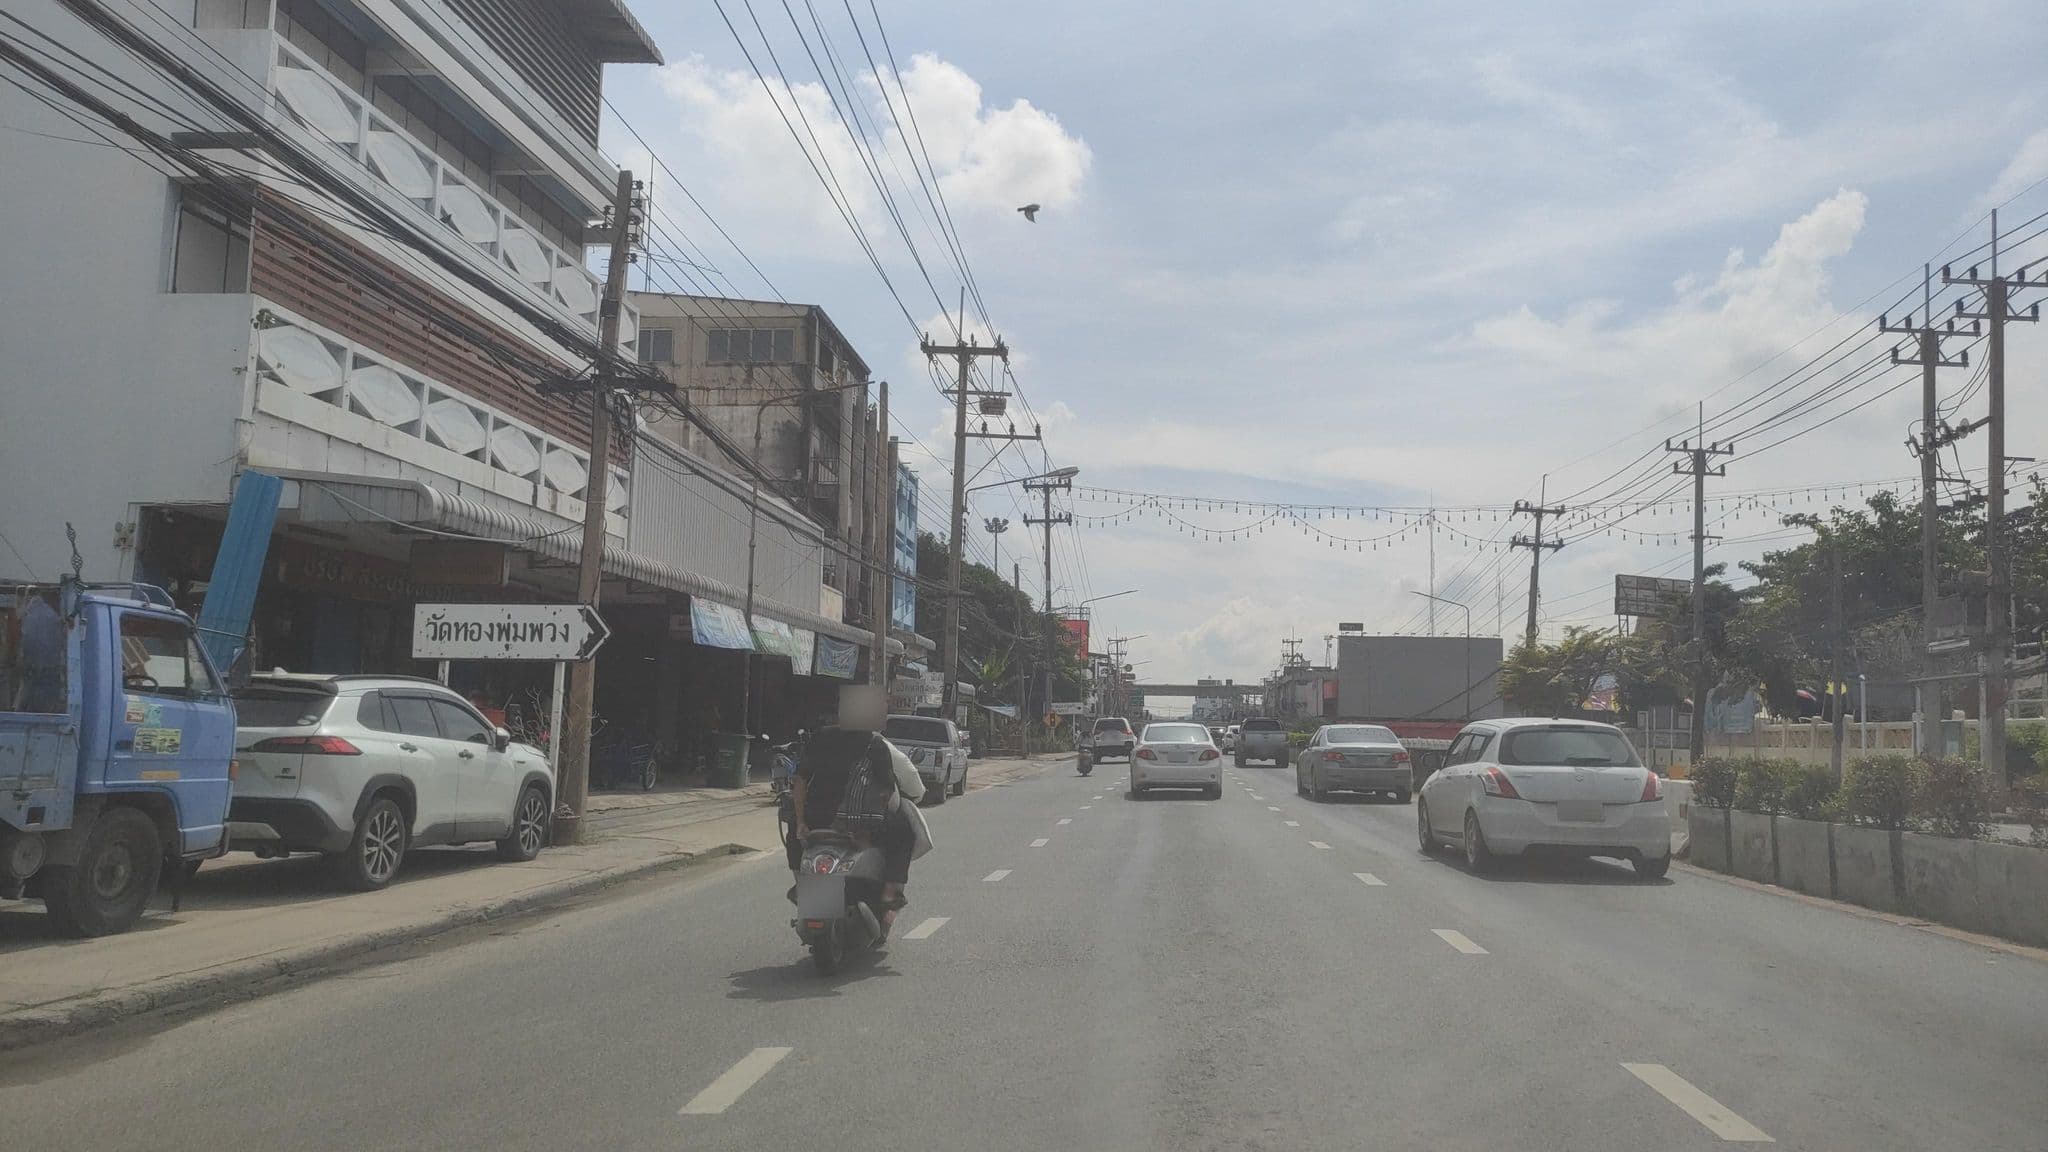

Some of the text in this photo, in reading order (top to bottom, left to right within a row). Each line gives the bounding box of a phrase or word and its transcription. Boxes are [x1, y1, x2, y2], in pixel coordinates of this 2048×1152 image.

[426, 613, 569, 651] วัดทองพุ่มพวง
